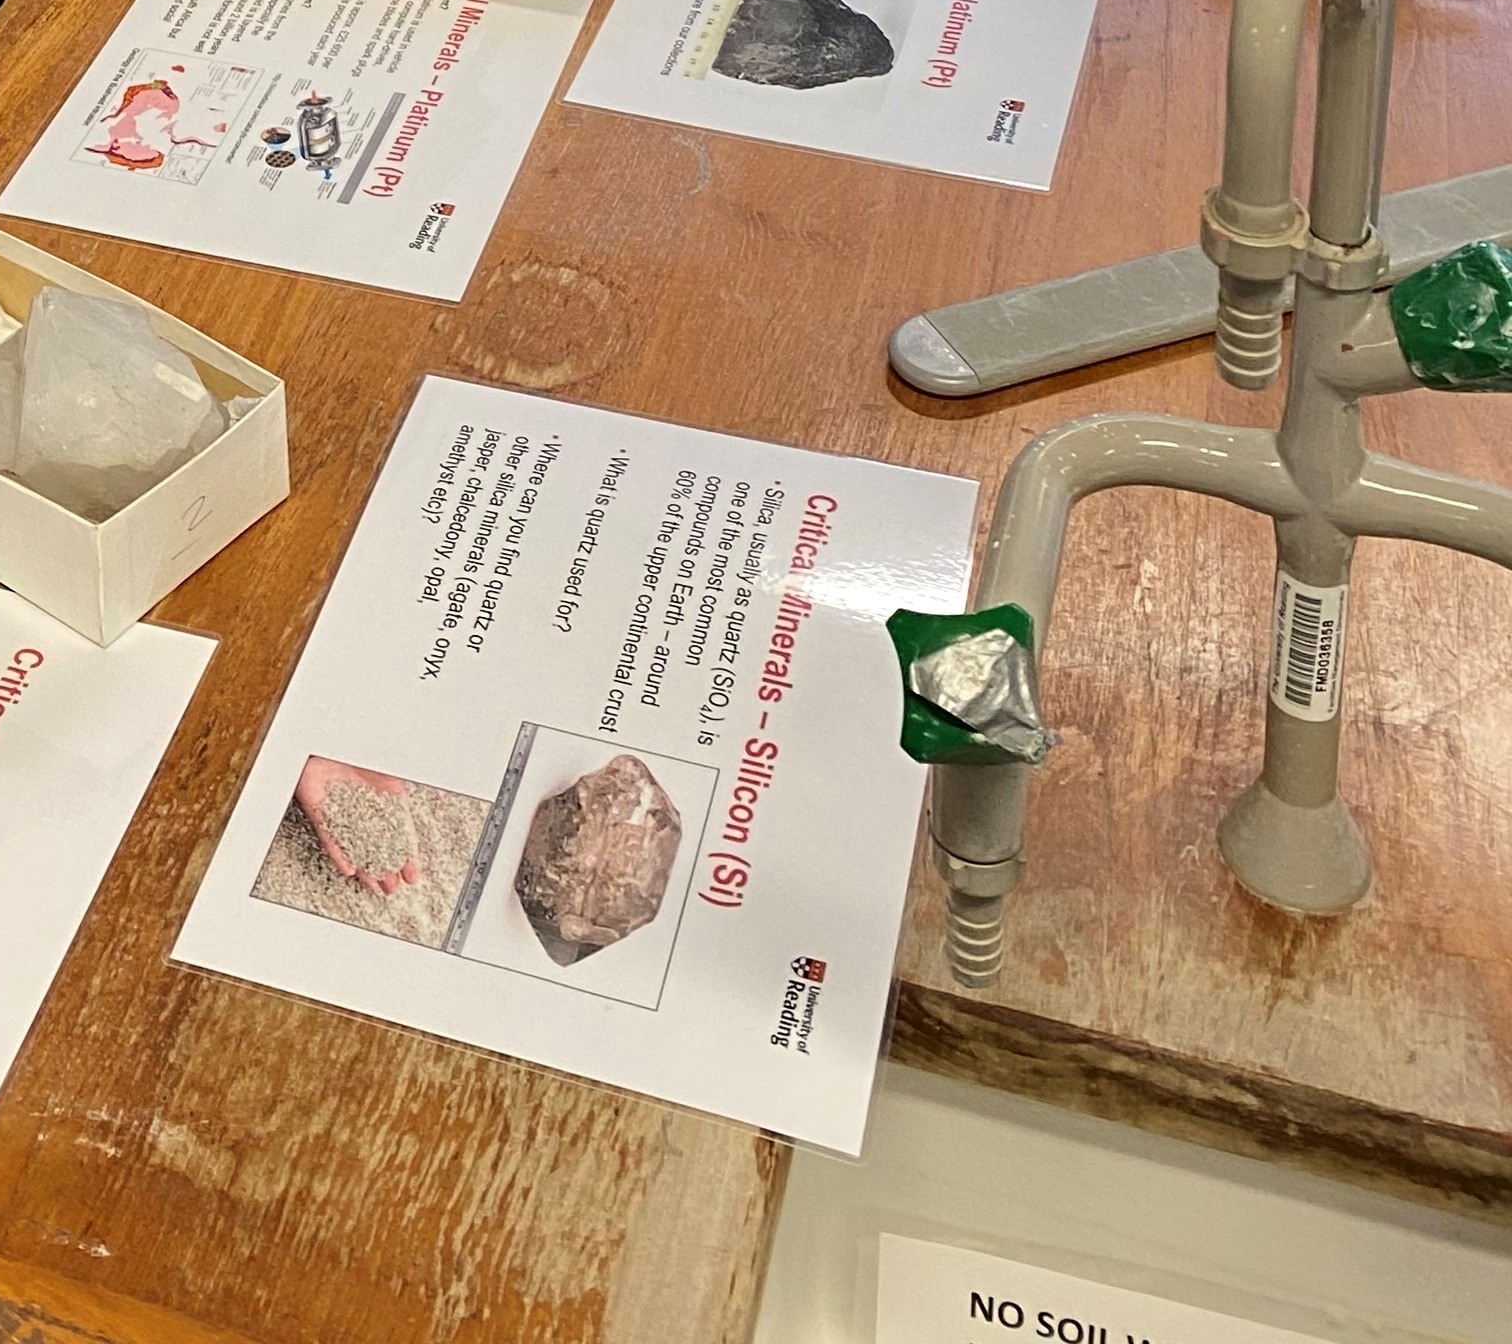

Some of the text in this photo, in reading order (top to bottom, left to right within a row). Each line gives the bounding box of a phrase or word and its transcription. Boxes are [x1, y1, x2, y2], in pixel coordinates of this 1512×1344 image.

[432, 6, 484, 70] Minerals
[919, 56, 960, 90] (Pt)
[385, 89, 443, 161] Platinum
[986, 110, 1010, 142] Reading
[362, 166, 404, 197] (Pt)
[408, 214, 438, 249] Reading
[420, 424, 473, 524] amethyst etc)?
[416, 428, 505, 603] jasper, chalcedony, opal,
[683, 476, 720, 556] compounds
[752, 488, 784, 526] Silica,
[418, 436, 528, 679] other silica minerals (agate, onyx,
[466, 443, 560, 653] Where can you find quartz or
[551, 457, 629, 632] What is quartz used for?
[676, 559, 695, 578] on
[684, 481, 750, 665] one of the most common
[735, 532, 766, 584] usually
[598, 470, 696, 732] 60% of the upper continental crust
[662, 582, 693, 625] Earth
[733, 587, 751, 607] as
[718, 611, 745, 663] quartz
[1315, 620, 1335, 693] FMD036358
[640, 645, 669, 707] around
[696, 730, 719, 745] is
[721, 737, 778, 843] Silicon
[697, 852, 751, 907] (Si)
[769, 979, 805, 1048] Reading
[795, 984, 820, 1055] University of
[970, 1292, 1024, 1330] NO
